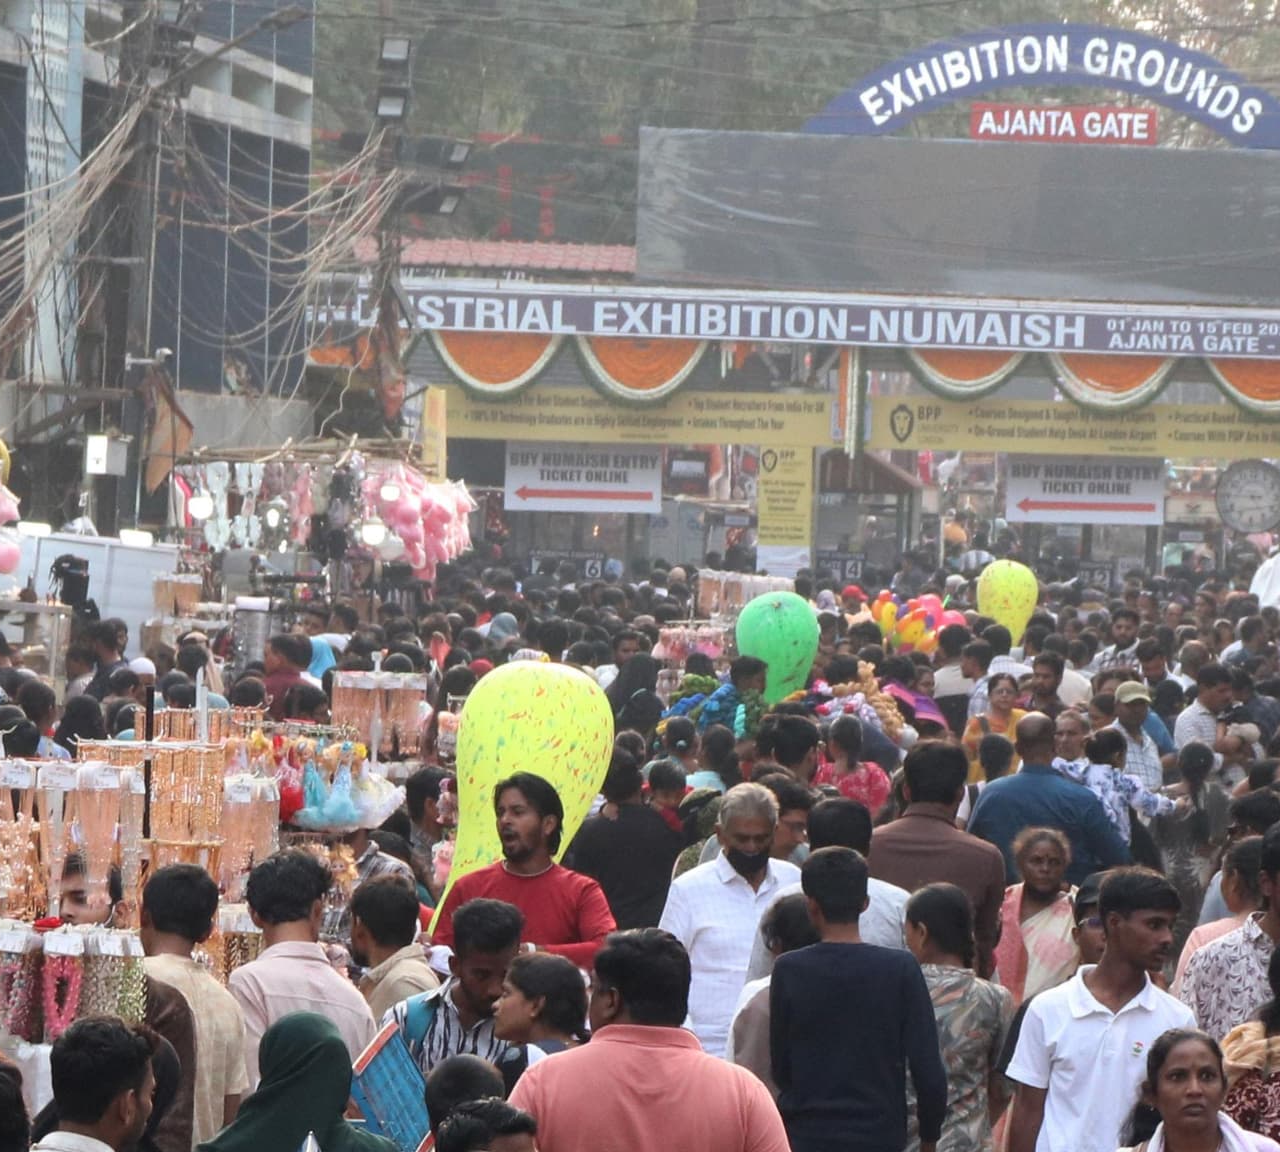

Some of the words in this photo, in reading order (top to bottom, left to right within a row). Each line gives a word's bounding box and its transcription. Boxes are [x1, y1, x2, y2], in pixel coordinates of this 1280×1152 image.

[859, 35, 1068, 126] EXHIBITION
[1083, 37, 1263, 134] GROUNDS
[978, 110, 1077, 138] AJANTA
[1083, 112, 1149, 140] GATE
[593, 301, 1086, 349] EXHIBITION-NUMAISH
[1132, 320, 1164, 333] JAN
[1170, 321, 1191, 334] TO
[1222, 322, 1253, 336] FEB
[1109, 333, 1195, 351] AJANTA
[1203, 336, 1262, 353] GATE
[918, 406, 942, 420] BPP
[510, 452, 538, 468] BUY
[542, 453, 610, 470] NUMAISH
[613, 454, 658, 471] ENTRY
[538, 468, 582, 482] TICKET
[585, 470, 628, 484] ONLINE
[1012, 463, 1038, 479] BUY
[1041, 464, 1113, 480] NUMAISH
[1116, 465, 1161, 481] ENTRY
[1041, 480, 1084, 494] TICKET
[1087, 482, 1131, 496] ONLINE
